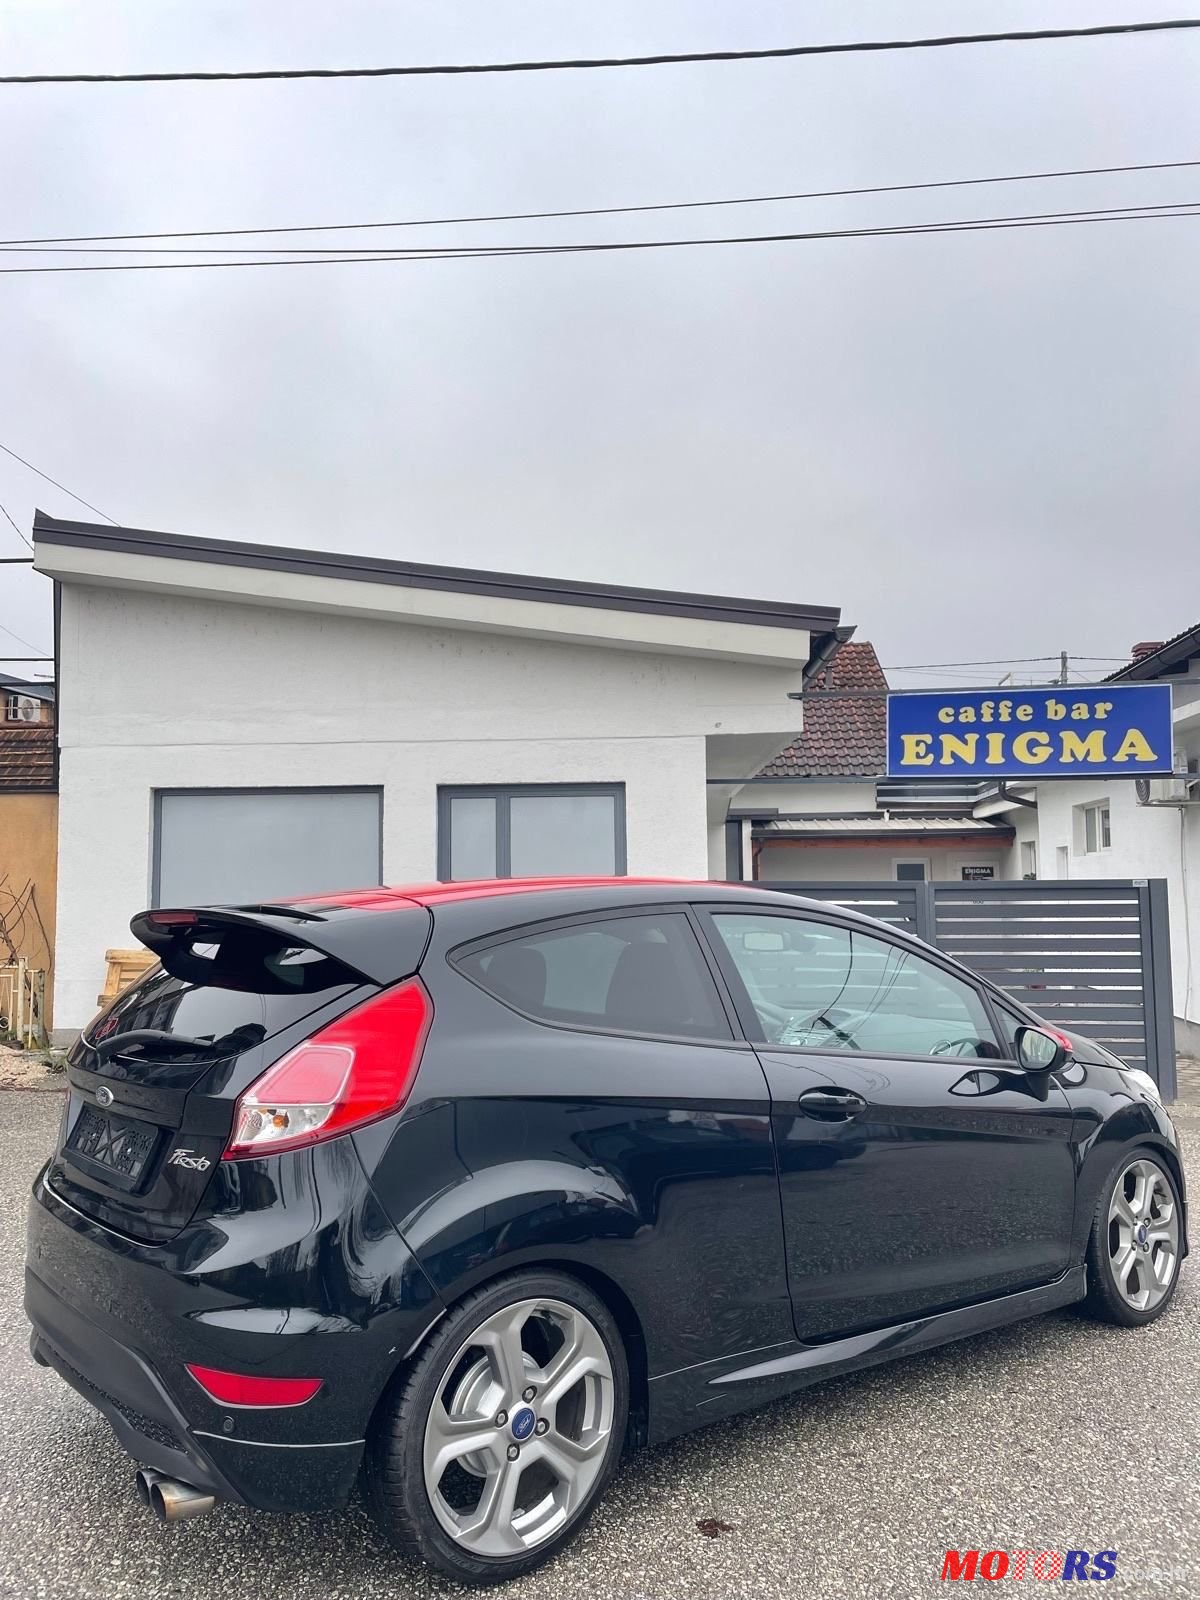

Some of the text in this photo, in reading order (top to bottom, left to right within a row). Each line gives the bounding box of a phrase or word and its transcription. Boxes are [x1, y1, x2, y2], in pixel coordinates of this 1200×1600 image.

[938, 699, 1114, 724] caffe bar
[900, 728, 1159, 766] ENIGMA
[167, 1148, 211, 1172] Fiesta
